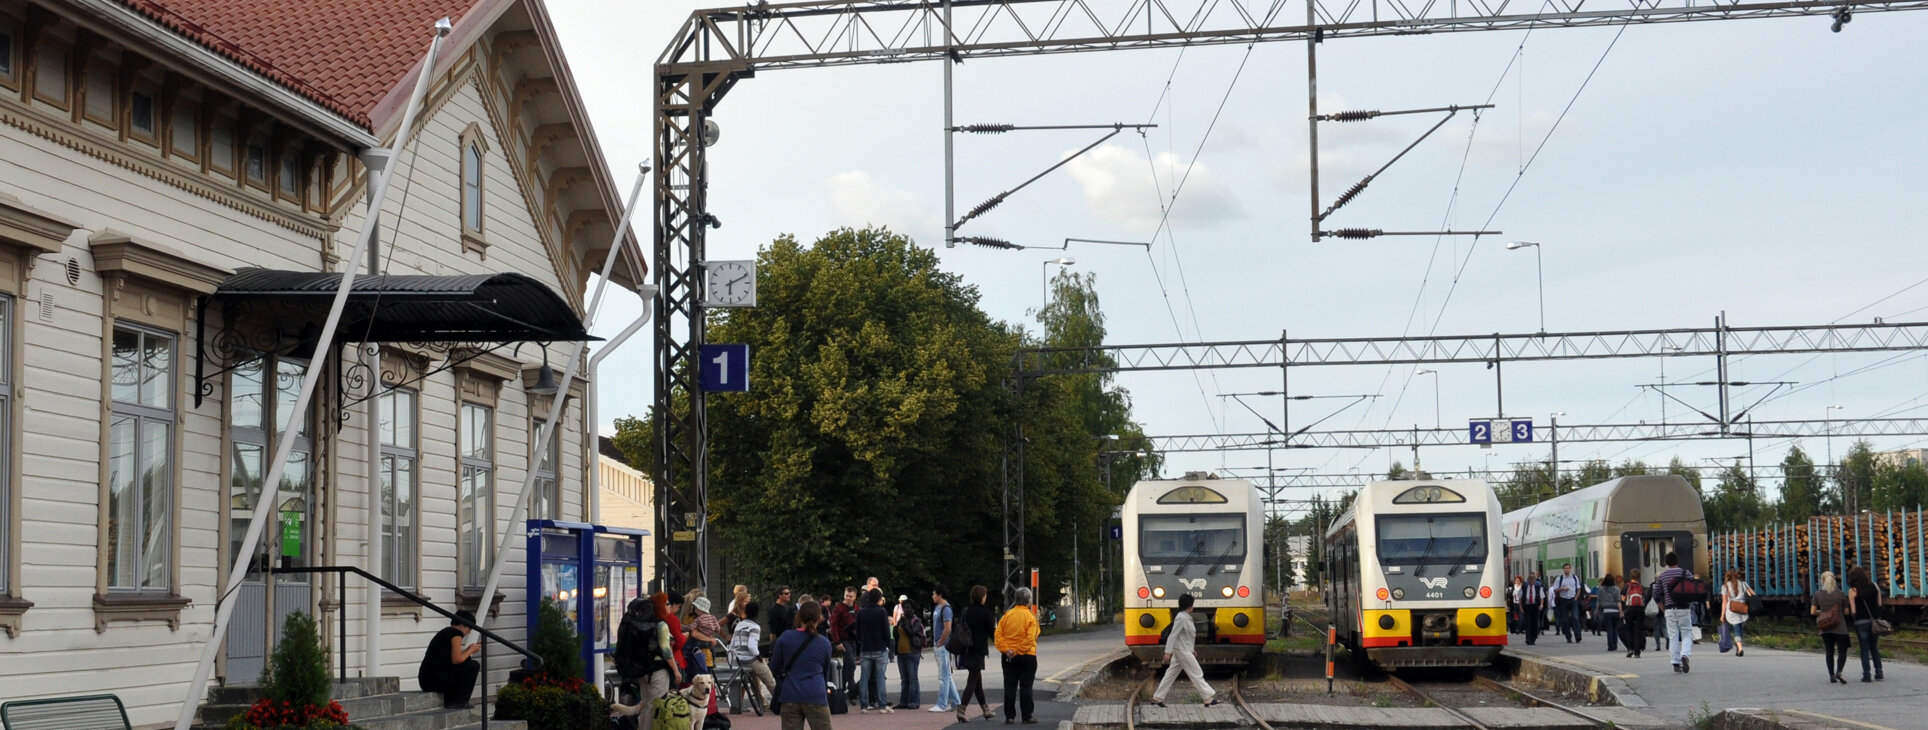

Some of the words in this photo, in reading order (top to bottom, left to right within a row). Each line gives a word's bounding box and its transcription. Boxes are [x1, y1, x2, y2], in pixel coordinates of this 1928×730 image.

[713, 352, 728, 384] 1
[1475, 425, 1487, 440] 2
[1517, 424, 1528, 439] 3
[1114, 528, 1119, 538] 1
[1179, 578, 1207, 590] VR
[1419, 577, 1448, 589] VR
